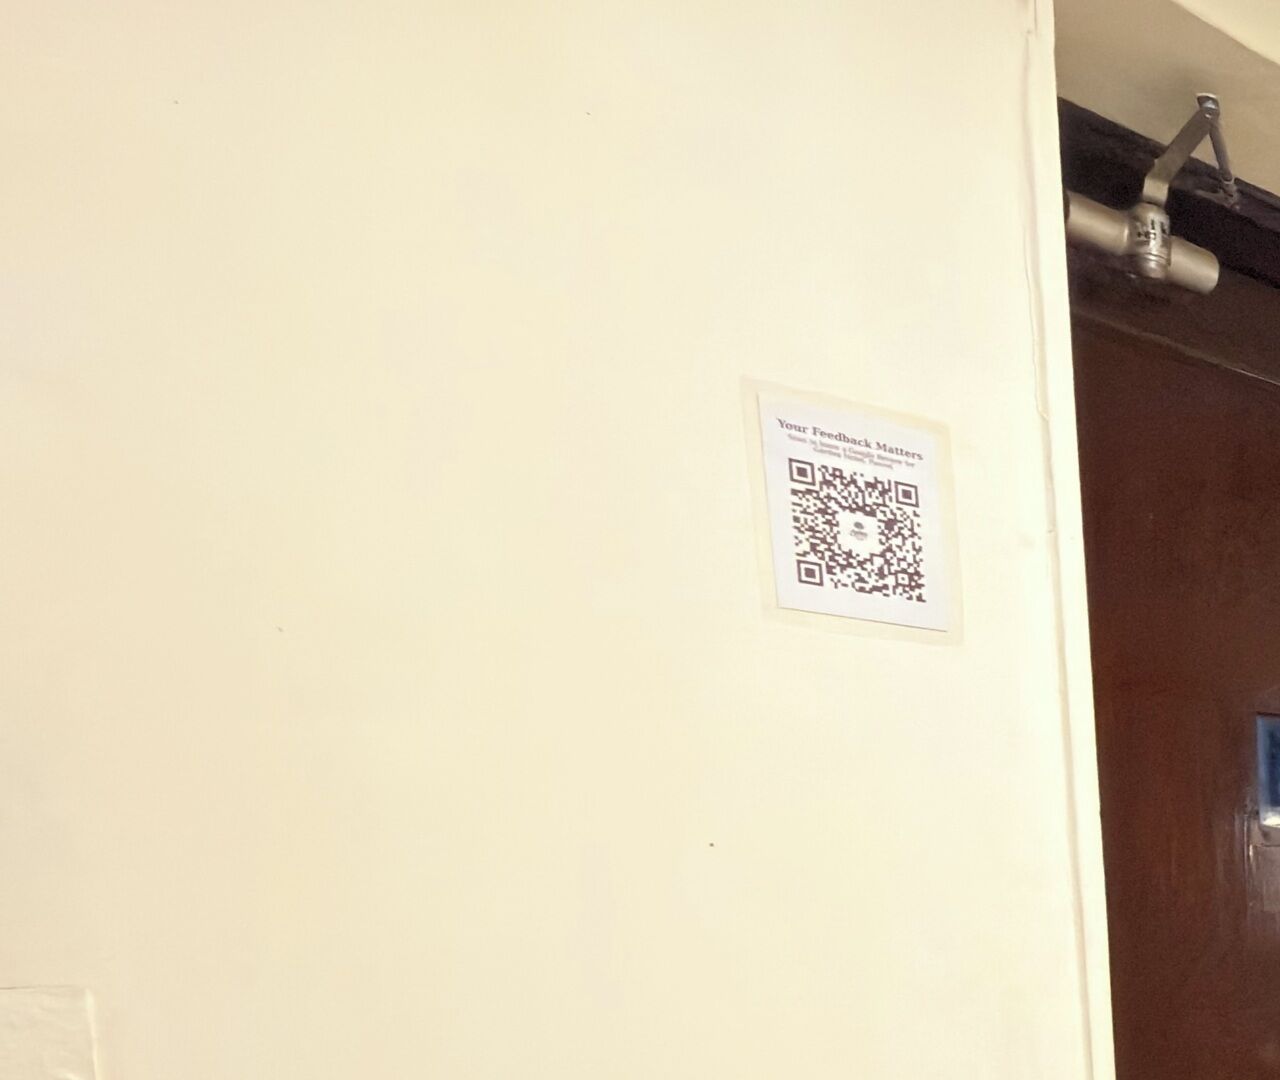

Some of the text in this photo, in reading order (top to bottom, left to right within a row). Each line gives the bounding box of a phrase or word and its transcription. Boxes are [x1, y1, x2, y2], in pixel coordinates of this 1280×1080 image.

[777, 417, 808, 434] Your
[812, 426, 872, 449] Feedback
[876, 441, 923, 461] Matters
